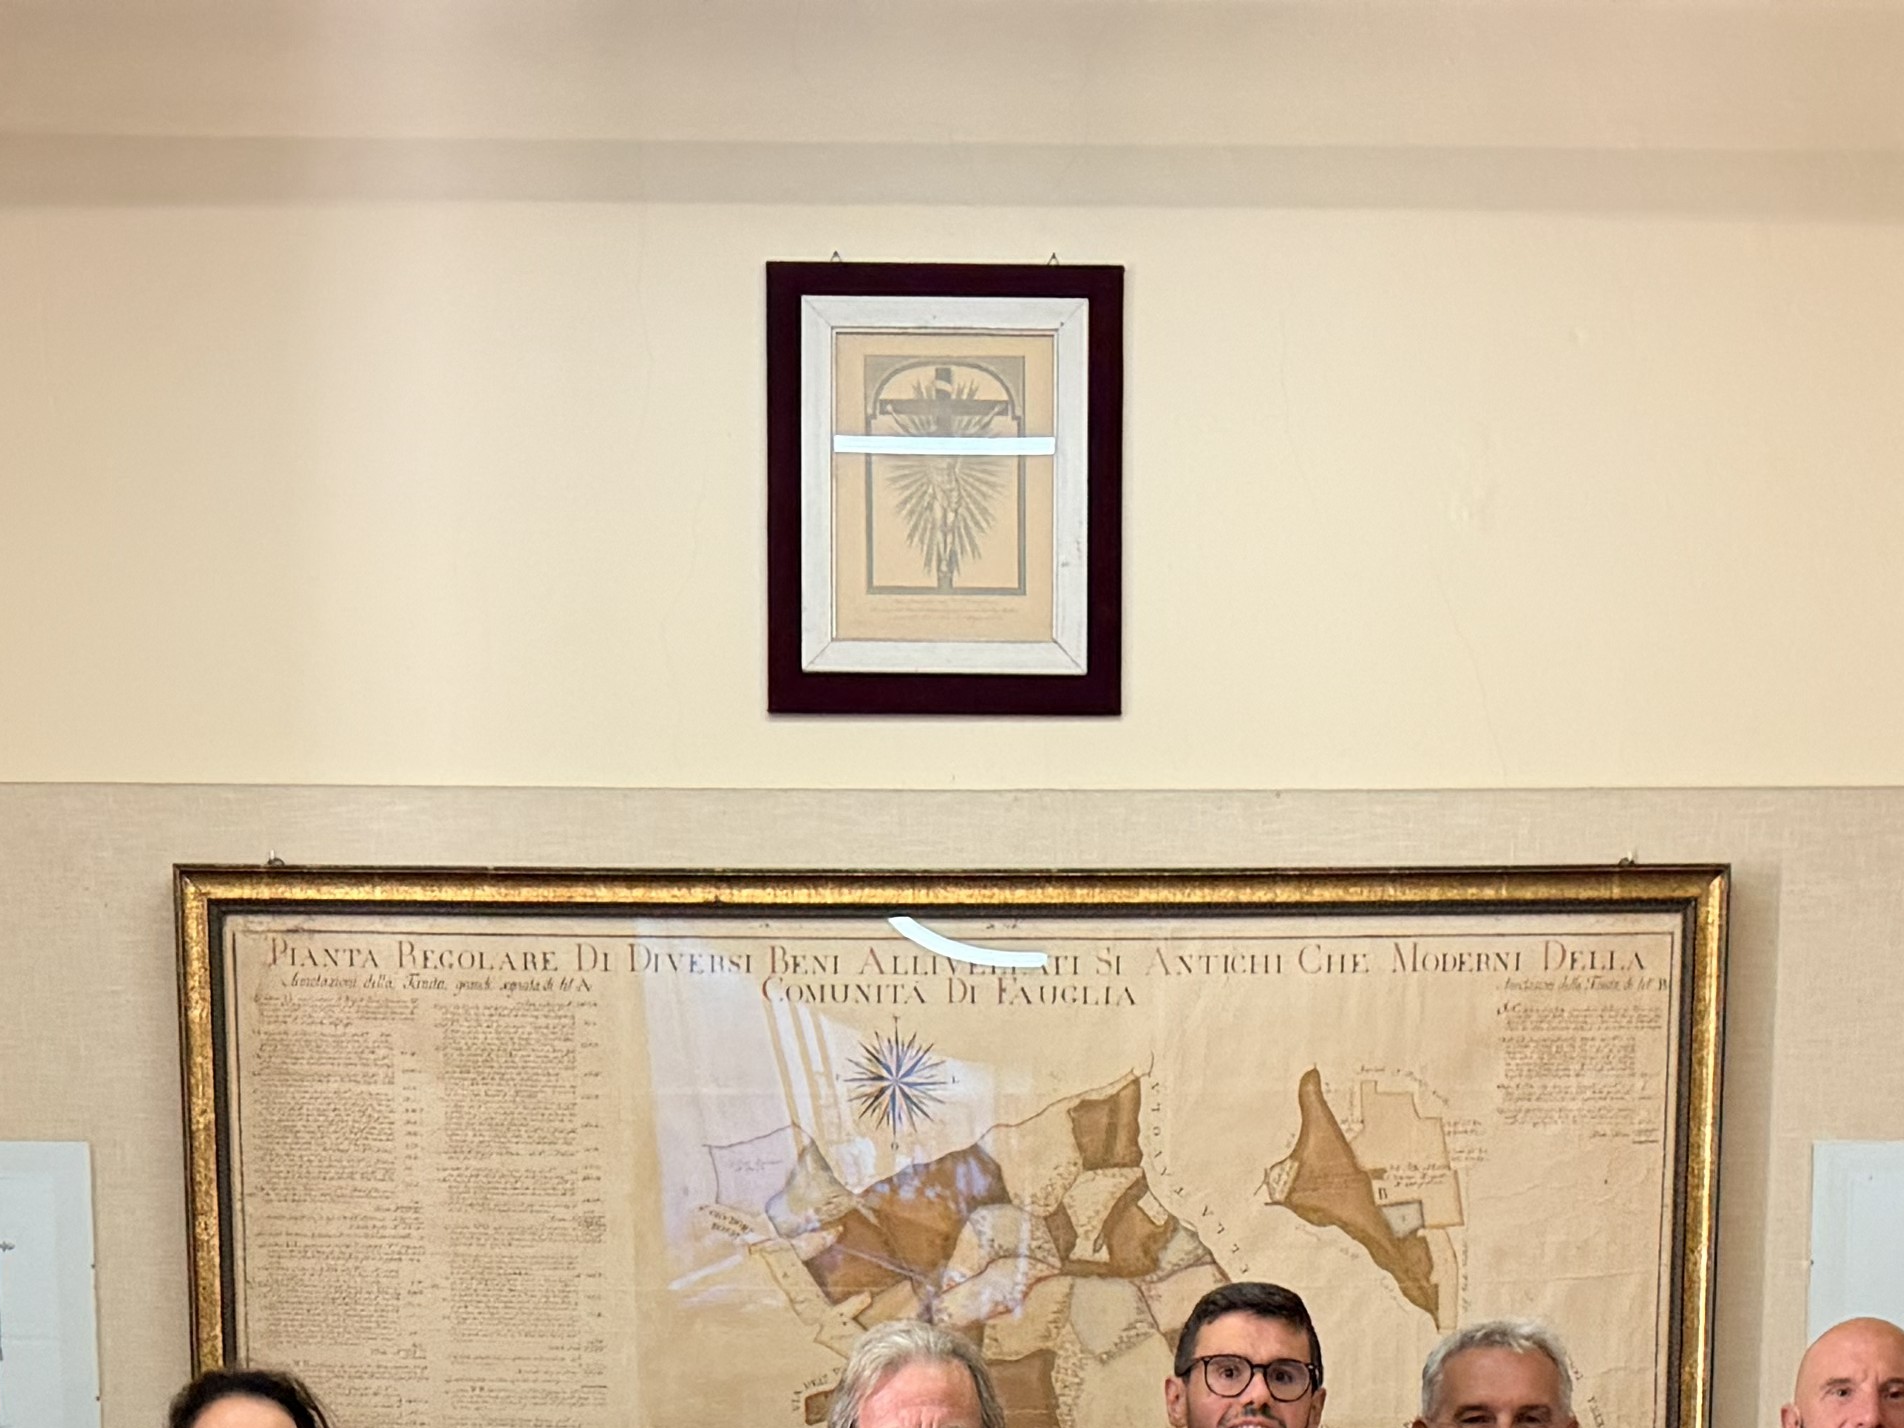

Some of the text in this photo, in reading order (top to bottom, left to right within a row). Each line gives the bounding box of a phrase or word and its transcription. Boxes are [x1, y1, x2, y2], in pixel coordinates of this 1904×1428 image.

[270, 937, 380, 969] PIANTA
[397, 940, 559, 972] REGOLARE
[576, 942, 613, 972] DI
[628, 943, 752, 974] DIVERSI
[768, 945, 840, 976] BENI
[1145, 946, 1283, 977] ANTICHI
[1298, 943, 1371, 976] CHE
[1391, 942, 1521, 974] MODERNI
[1543, 939, 1648, 972] DELLA
[946, 977, 978, 1005] DI
[996, 977, 1138, 1006] FAUGLIA
